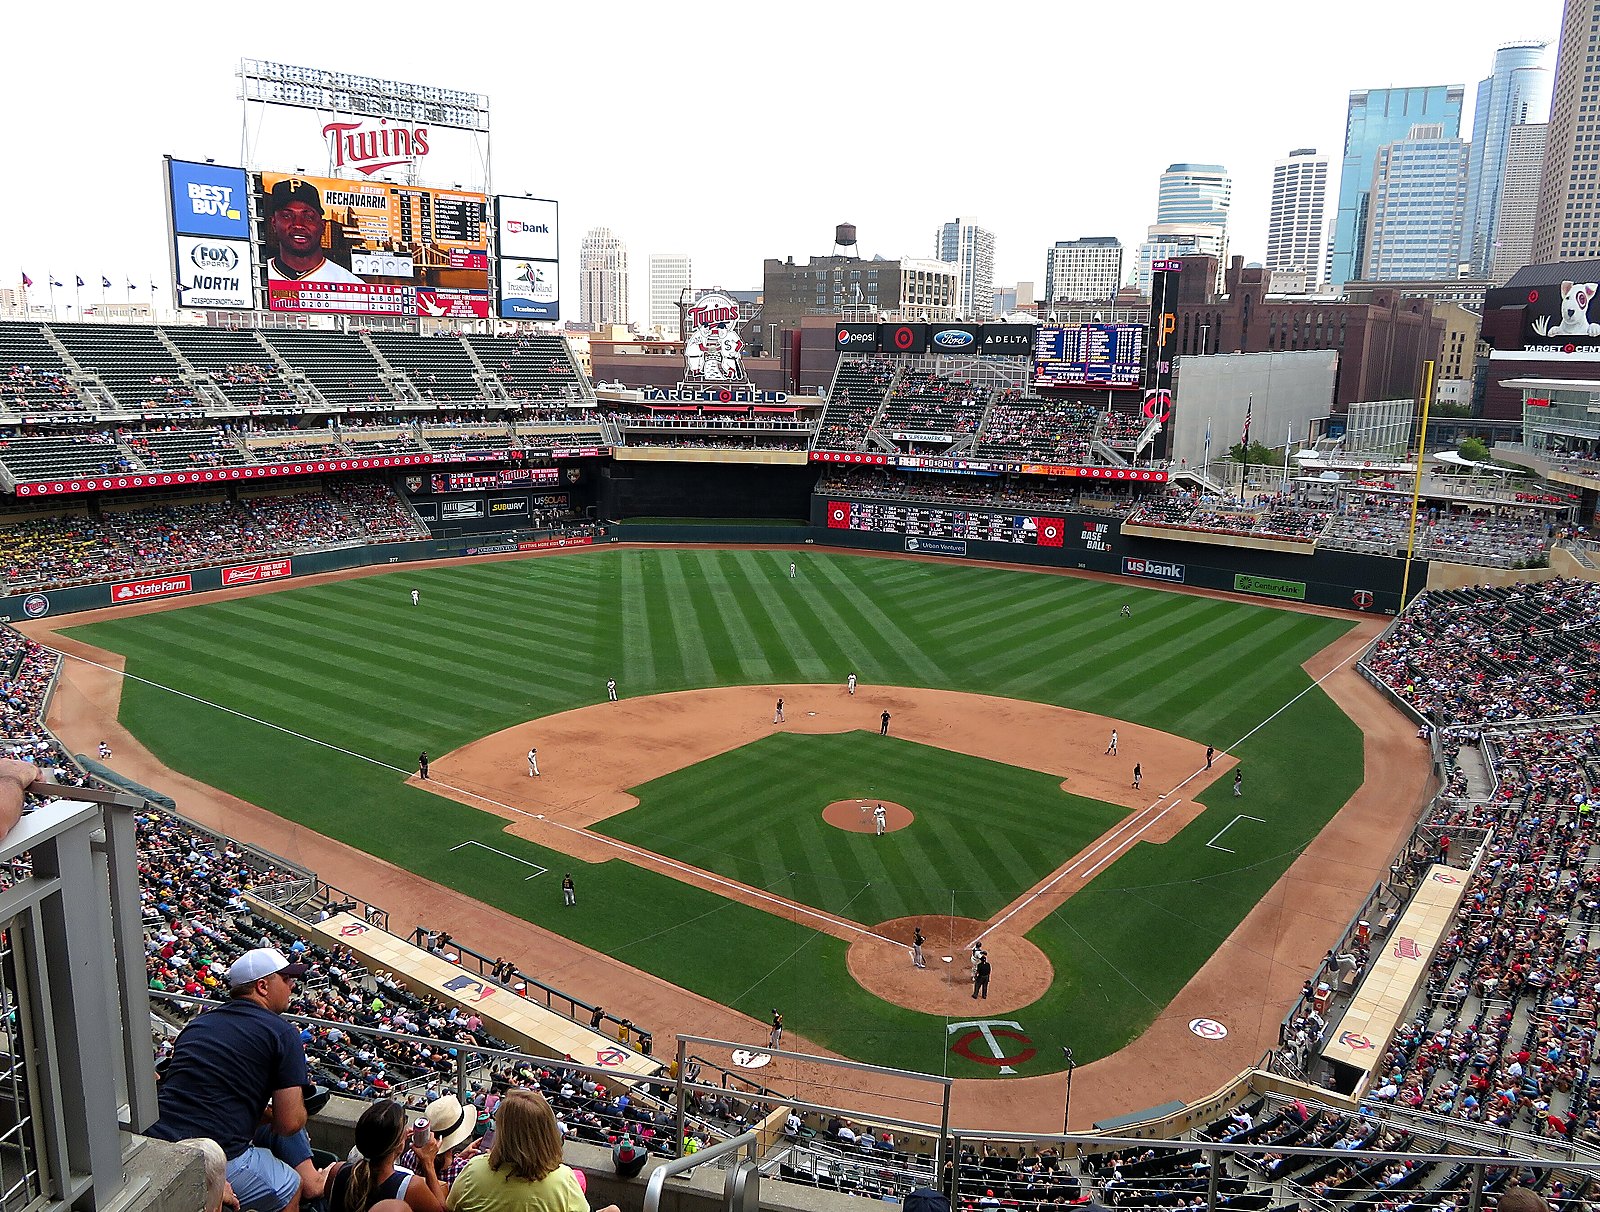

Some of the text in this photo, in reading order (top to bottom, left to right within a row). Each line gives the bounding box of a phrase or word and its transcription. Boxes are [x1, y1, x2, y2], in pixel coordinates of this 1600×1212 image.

[322, 118, 429, 171] Twins
[187, 182, 233, 202] BEST
[326, 191, 386, 209] HECHAVARRIA
[192, 198, 231, 218] BUY
[201, 247, 228, 262] FOX
[201, 260, 230, 268] SPORTS
[193, 275, 239, 291] NORTH
[688, 304, 739, 329] Twins
[850, 332, 875, 347] pepsi
[941, 332, 966, 345] Ford
[995, 335, 1028, 344] DELTA
[1524, 344, 1563, 352] TARGET
[644, 390, 788, 403] TARGET FIELD
[511, 450, 524, 459] 94
[492, 501, 524, 512] SUBWAY
[1096, 524, 1108, 533] WE
[1081, 530, 1102, 541] BASE
[1086, 540, 1106, 551] BALL
[1254, 580, 1298, 594] CenturyLink
